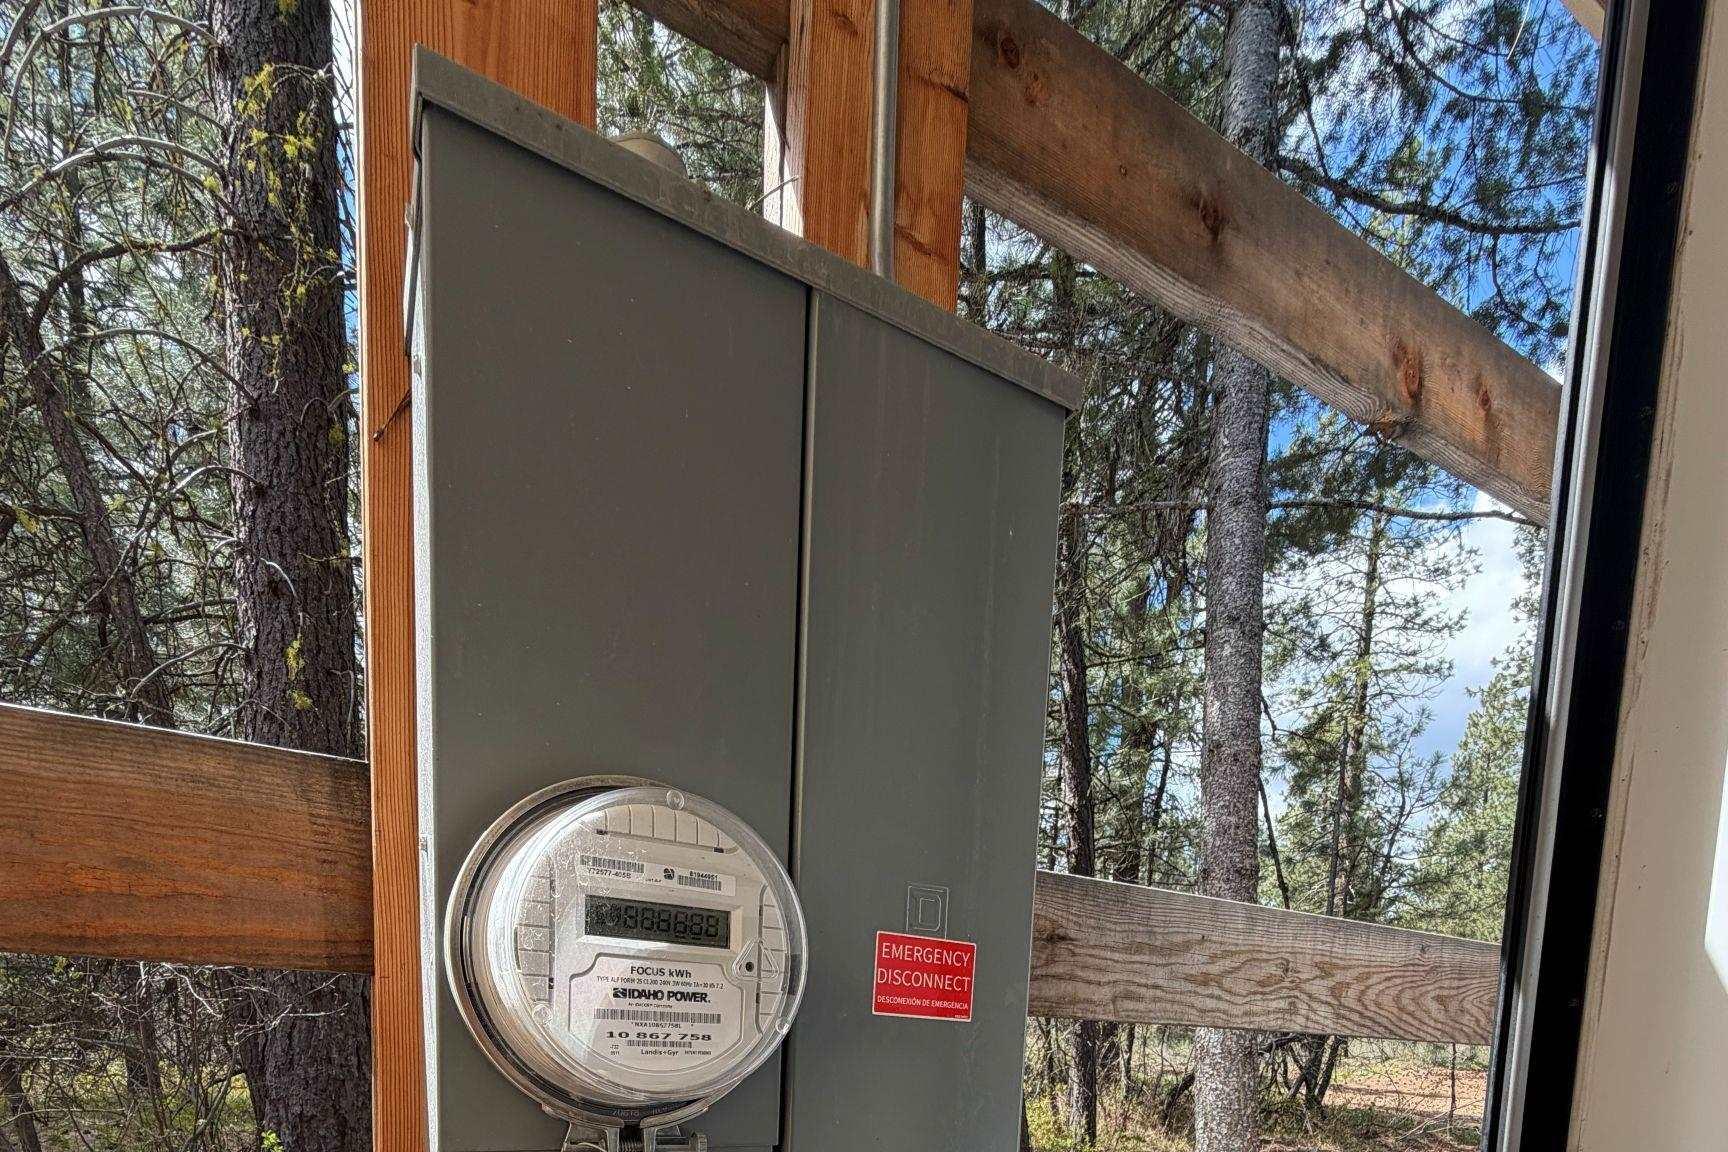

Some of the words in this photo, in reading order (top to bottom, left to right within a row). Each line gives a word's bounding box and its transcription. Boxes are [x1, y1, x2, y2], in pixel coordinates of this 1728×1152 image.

[881, 942, 971, 968] EMERGENCY
[630, 966, 666, 977] FOCUS
[669, 968, 692, 979] kWh
[877, 968, 971, 992] DISCONNECT
[628, 988, 665, 1001] IDAHO
[877, 995, 921, 1006] DESCONEXIÓN
[922, 999, 930, 1007] DE
[931, 1000, 969, 1010] EMERGENCIA
[606, 1031, 630, 1039] 10
[636, 1032, 672, 1040] 867
[678, 1033, 712, 1041] 758
